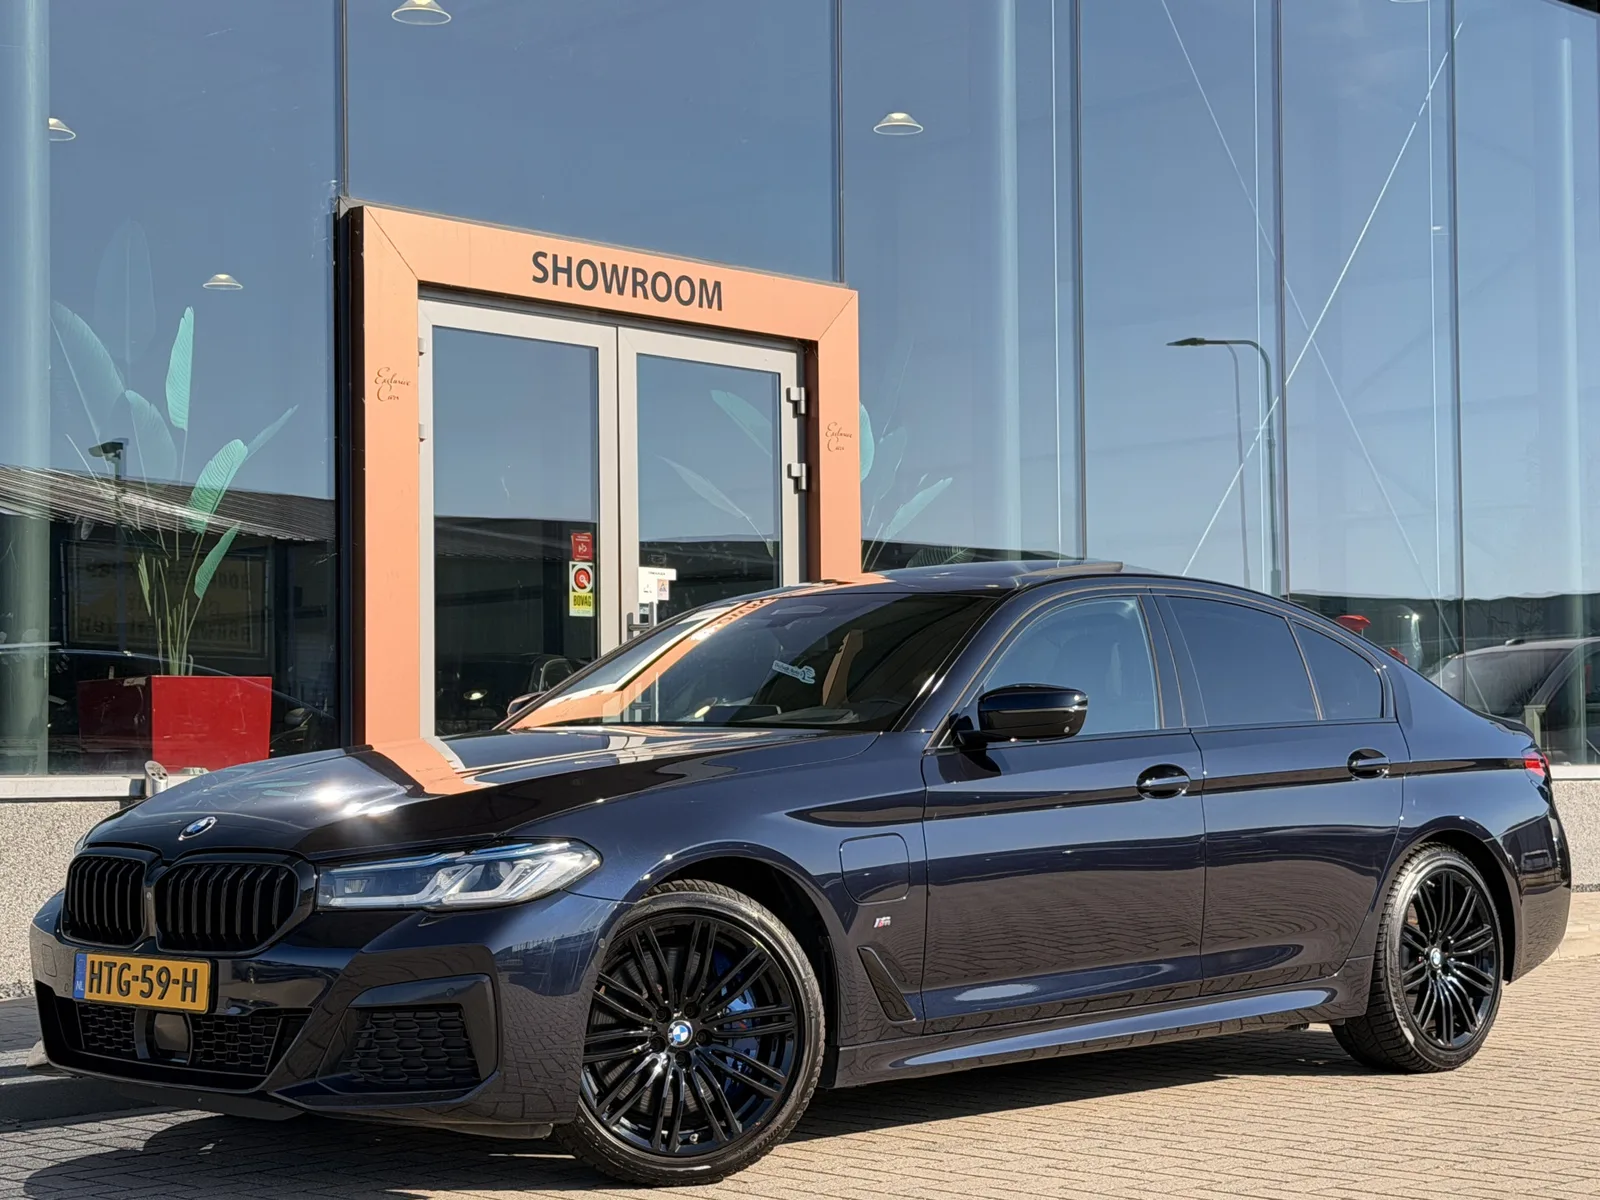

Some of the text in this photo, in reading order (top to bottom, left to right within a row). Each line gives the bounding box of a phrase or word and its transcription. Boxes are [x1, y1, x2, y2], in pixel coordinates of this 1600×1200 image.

[532, 251, 722, 311] SHOWROOM
[573, 594, 592, 607] BOVAG
[75, 980, 84, 991] NL
[88, 960, 198, 1003] HTG-59-H
